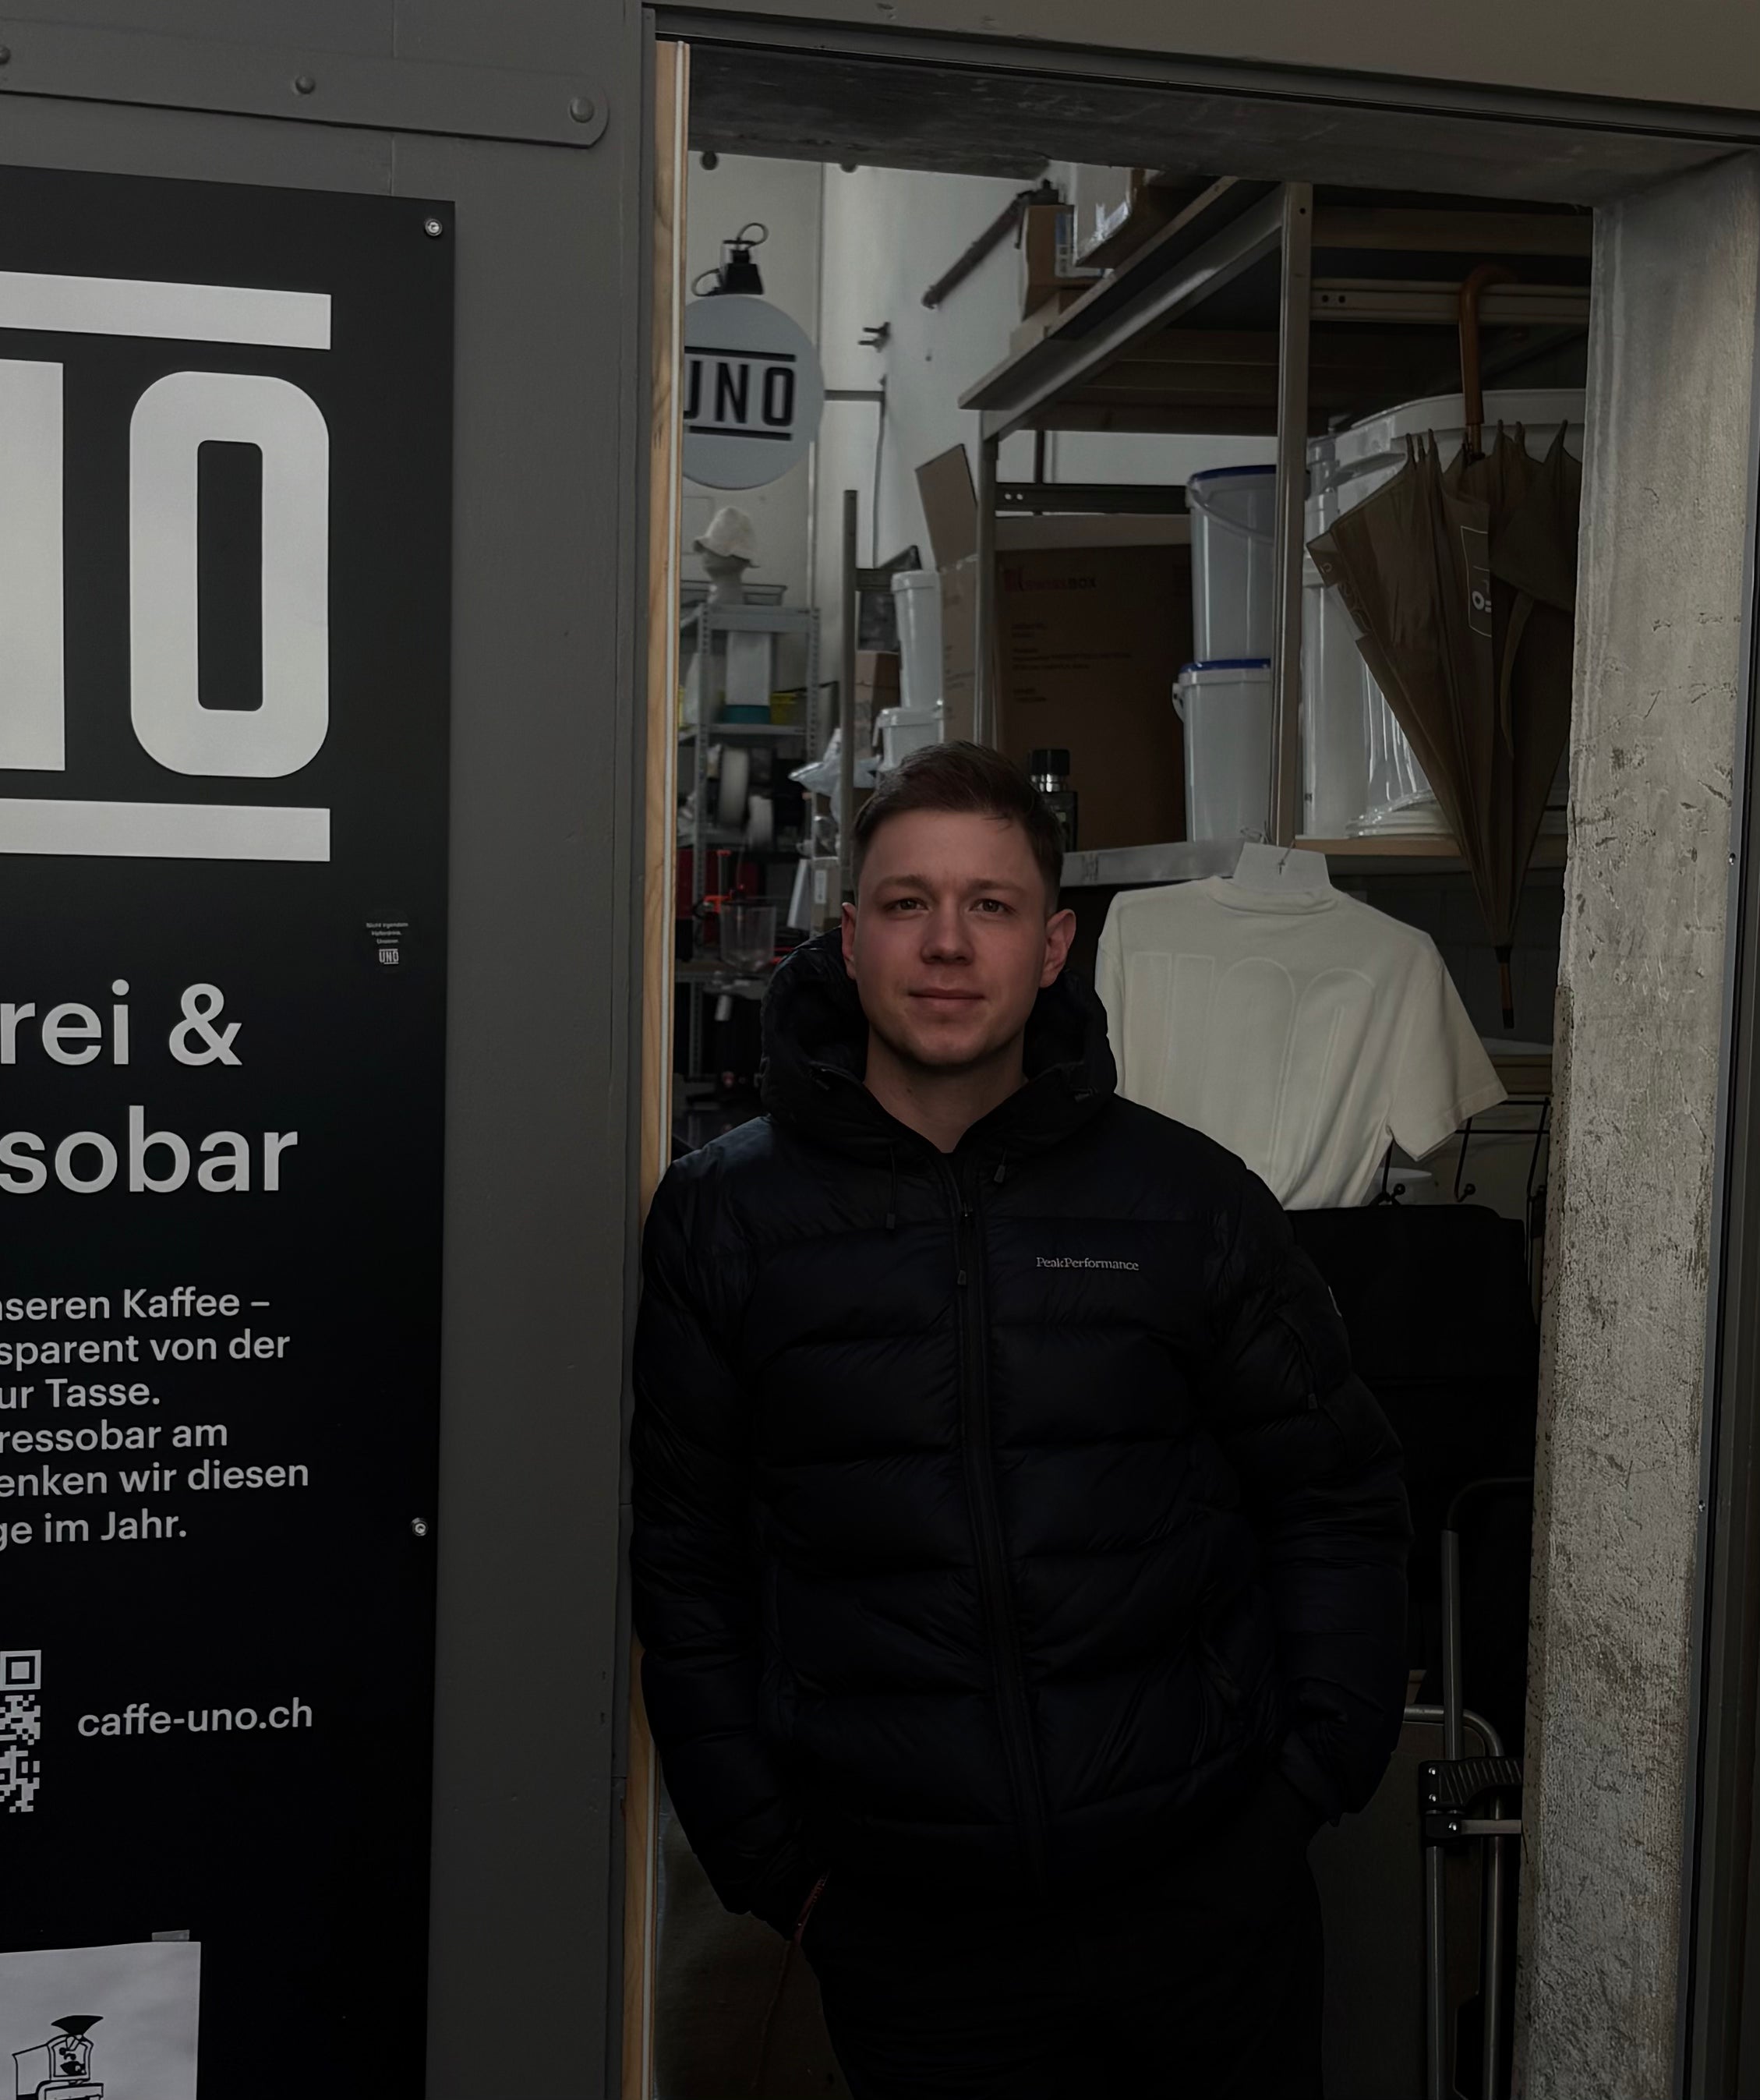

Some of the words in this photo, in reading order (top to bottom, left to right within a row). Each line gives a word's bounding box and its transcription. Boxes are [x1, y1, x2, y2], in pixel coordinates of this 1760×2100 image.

[379, 950, 399, 963] UNO
[0, 979, 129, 1066] rei
[168, 983, 243, 1066] &
[0, 1105, 299, 1194] sobar
[0, 1297, 110, 1321] seren
[124, 1286, 240, 1319] Kaffee
[0, 1335, 140, 1372] sparent
[149, 1338, 217, 1362] von
[228, 1328, 291, 1359] der
[0, 1386, 34, 1409] ur
[44, 1378, 160, 1408] Tasse.
[0, 1419, 162, 1454] ressobar
[172, 1424, 228, 1448] am
[118, 1462, 177, 1493] wir
[187, 1458, 309, 1490] diesen
[44, 1512, 89, 1543] im
[101, 1508, 187, 1541] Jahr.
[77, 1696, 313, 1737] caffe-uno.ch
